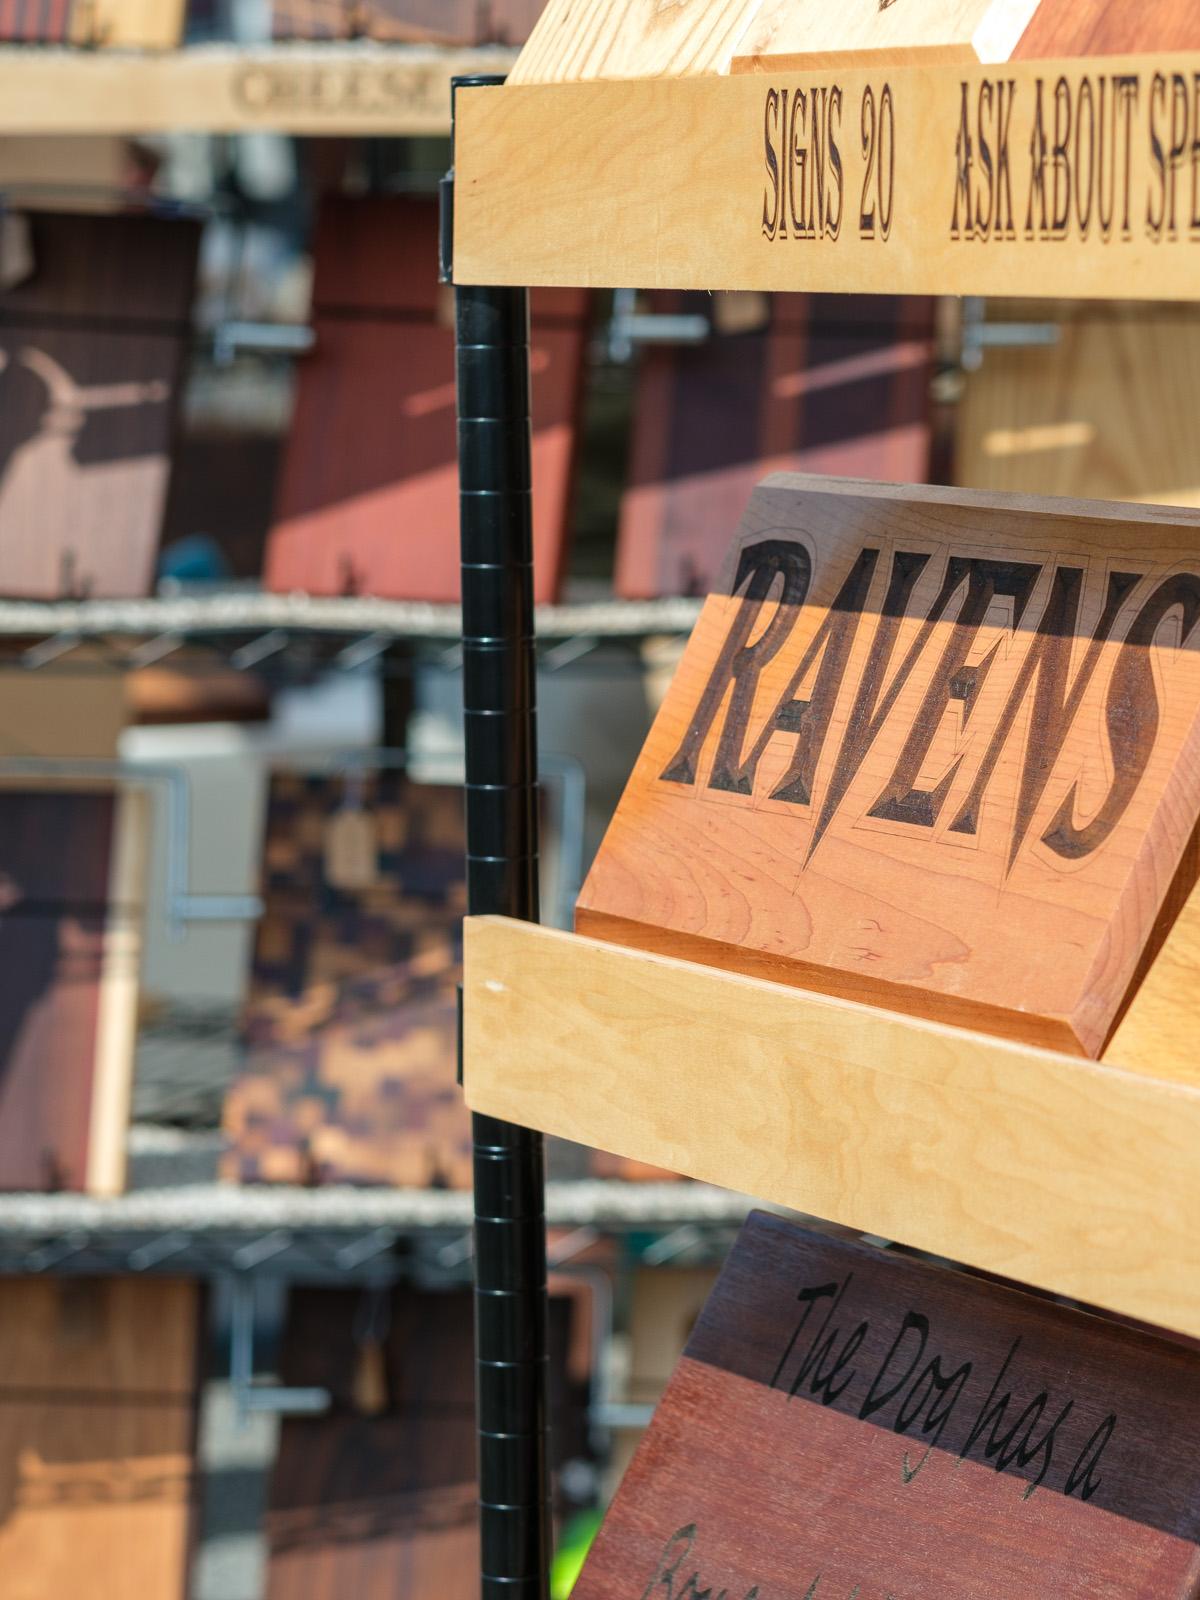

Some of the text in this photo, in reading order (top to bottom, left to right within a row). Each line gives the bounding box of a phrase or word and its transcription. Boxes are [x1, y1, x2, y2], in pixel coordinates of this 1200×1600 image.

[762, 85, 844, 243] SIGNS
[859, 82, 896, 243] 20
[950, 77, 1018, 244] ASK
[1024, 73, 1139, 245] ABOUT
[769, 1271, 1117, 1501] The Dog has a
